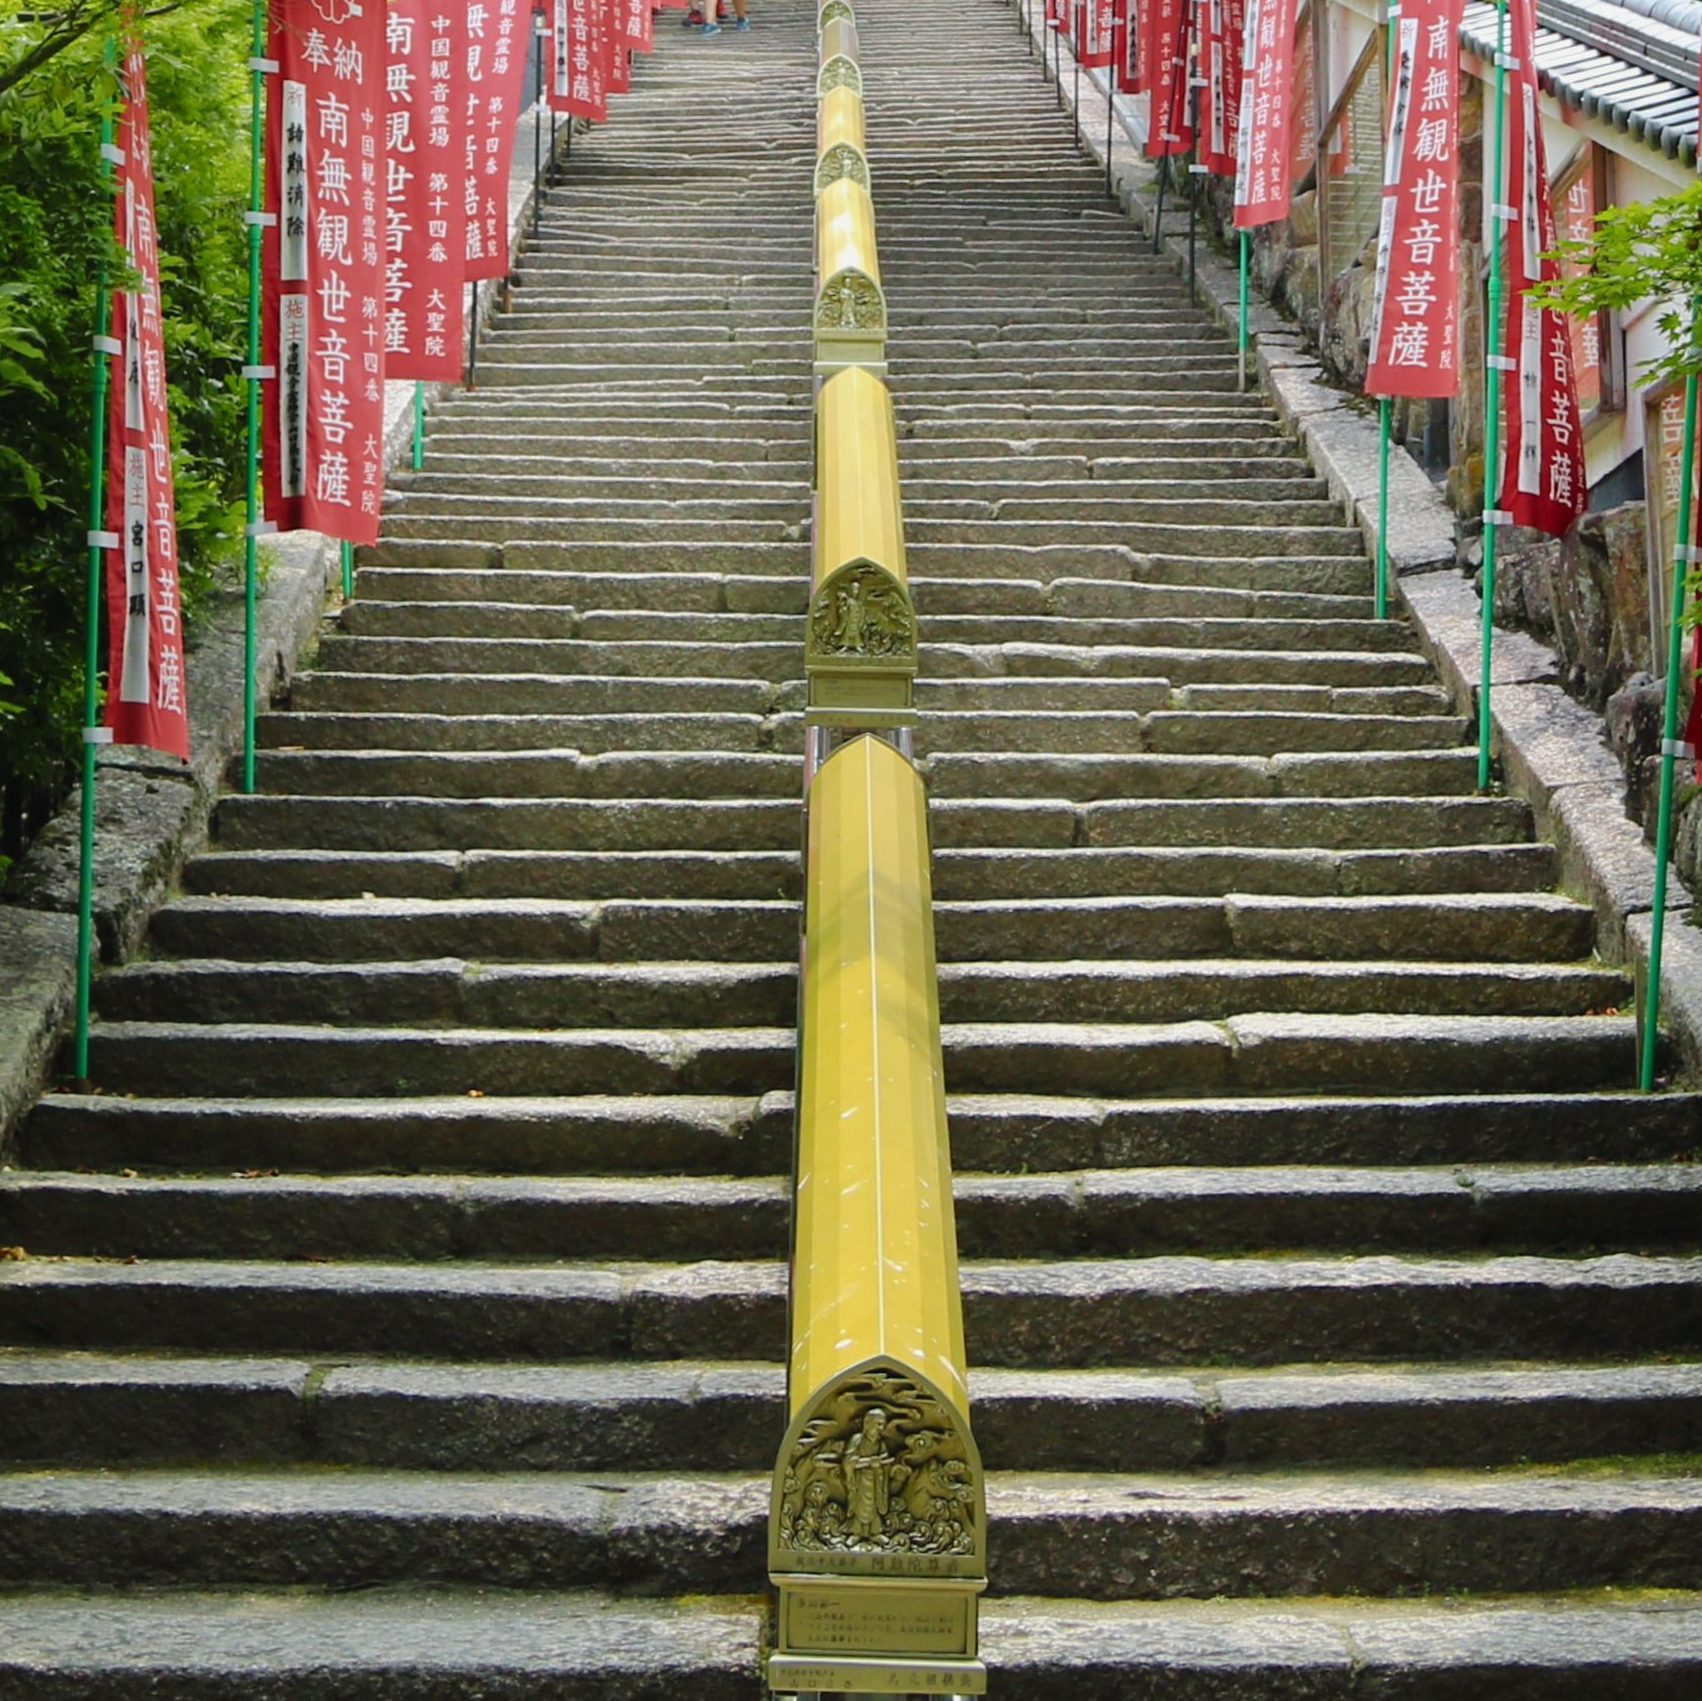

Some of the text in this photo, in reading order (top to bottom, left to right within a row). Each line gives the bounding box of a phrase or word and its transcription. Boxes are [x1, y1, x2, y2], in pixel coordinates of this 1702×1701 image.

[300, 27, 363, 86] 奉納
[430, 15, 451, 147] 中国観音霊場
[360, 107, 379, 267] 中国観音霊場
[427, 172, 449, 263] 第十四番
[1388, 15, 1450, 369] 南無観世音菩薩
[315, 91, 354, 508] 南無観世音菩薩
[361, 296, 380, 403] 第十四番
[424, 288, 447, 358] 大聖院
[361, 433, 380, 515] 大聖院
